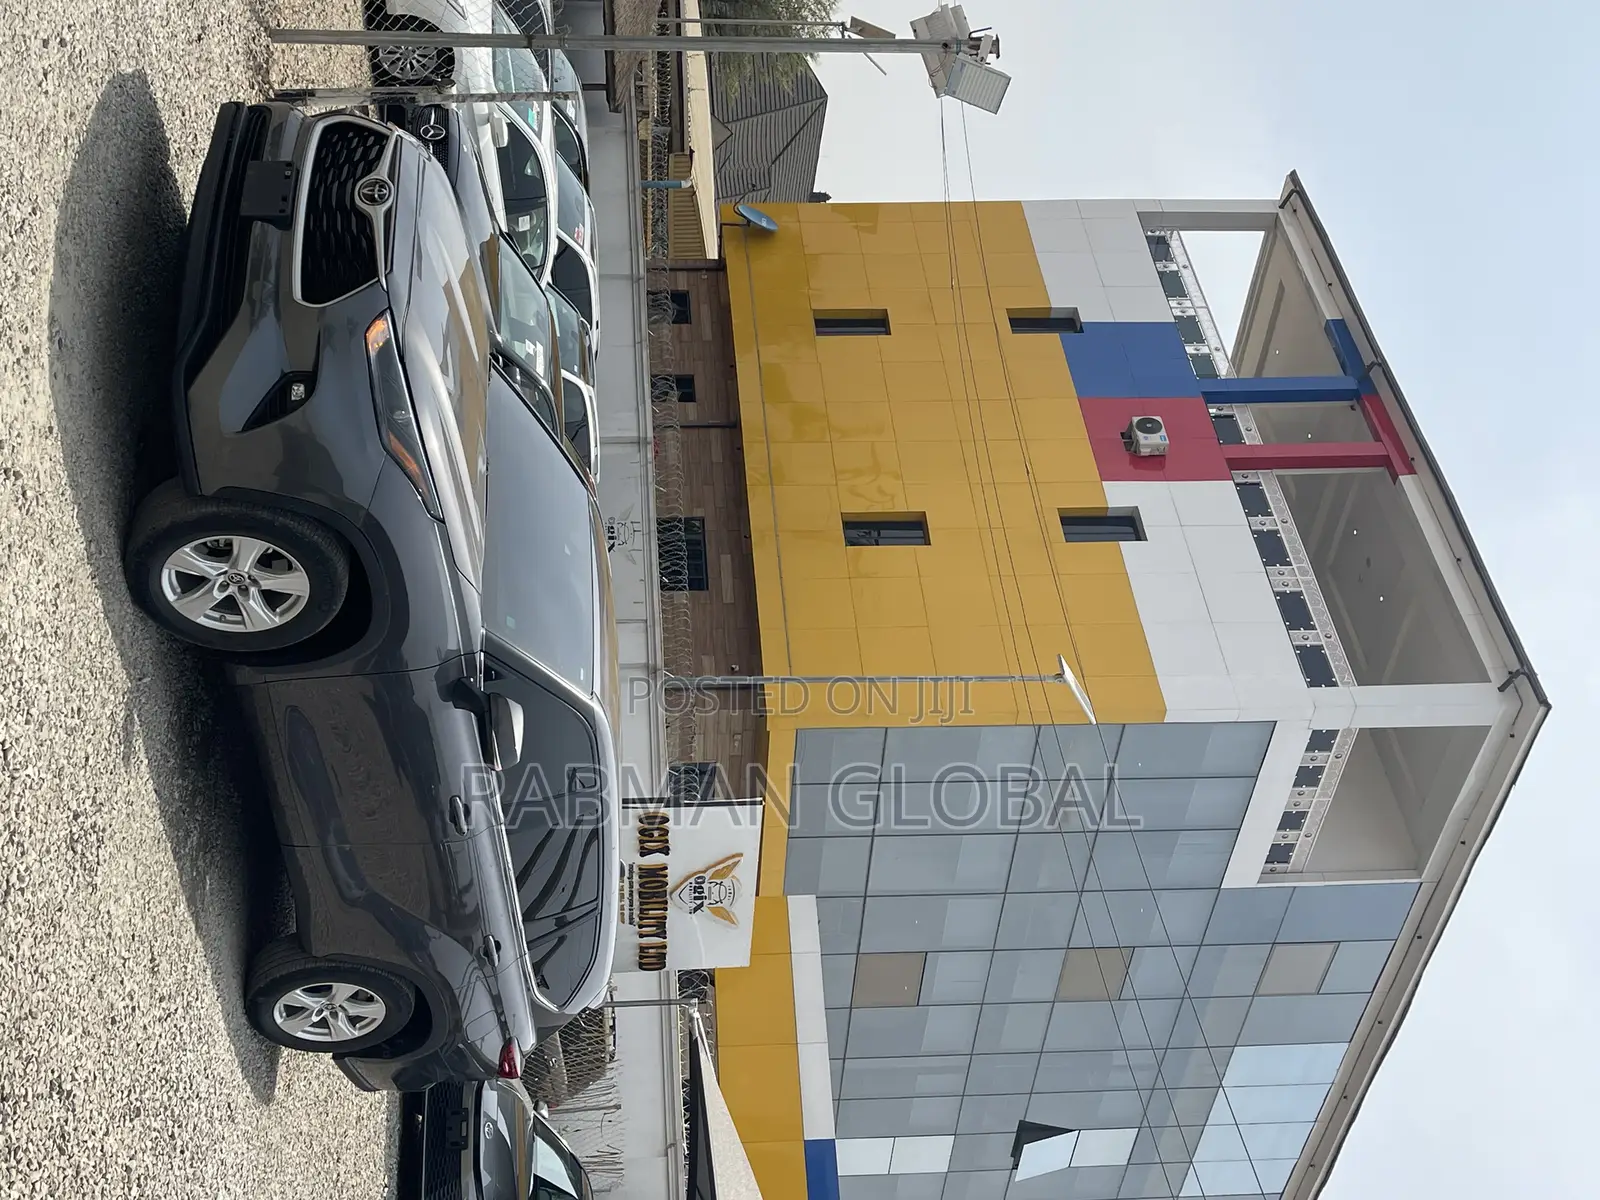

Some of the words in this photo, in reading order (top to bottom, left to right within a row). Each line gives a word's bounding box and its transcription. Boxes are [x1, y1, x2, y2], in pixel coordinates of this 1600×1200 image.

[638, 812, 671, 858] OGIX
[638, 863, 669, 939] MOBILITY
[638, 941, 668, 972] LTD
